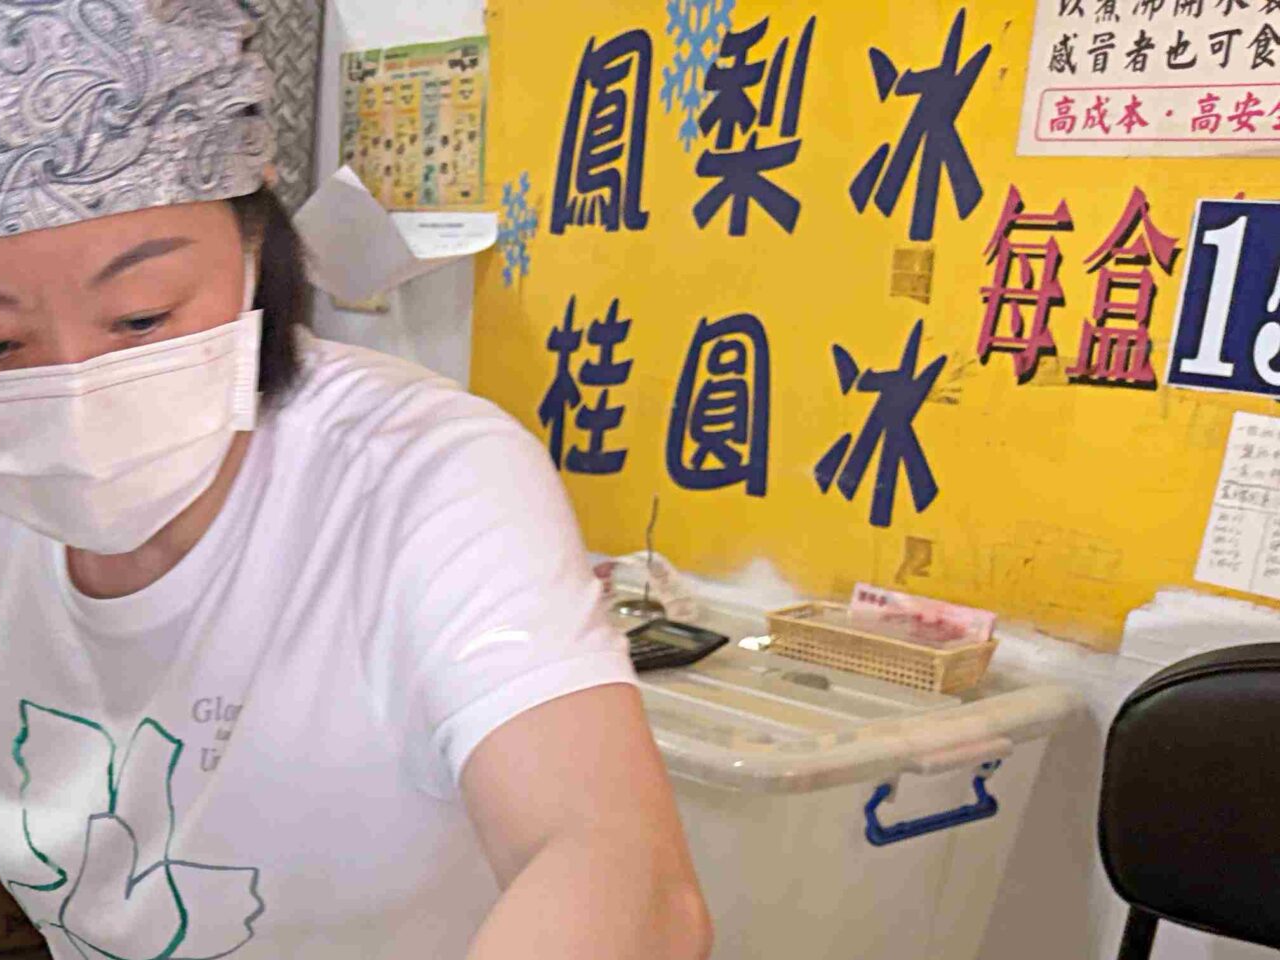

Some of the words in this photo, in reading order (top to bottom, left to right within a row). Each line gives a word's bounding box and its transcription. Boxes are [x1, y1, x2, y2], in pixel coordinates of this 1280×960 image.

[549, 7, 993, 241] 鳳梨冰
[977, 183, 1182, 391] 每盒
[538, 295, 948, 528] 桂圓冰
